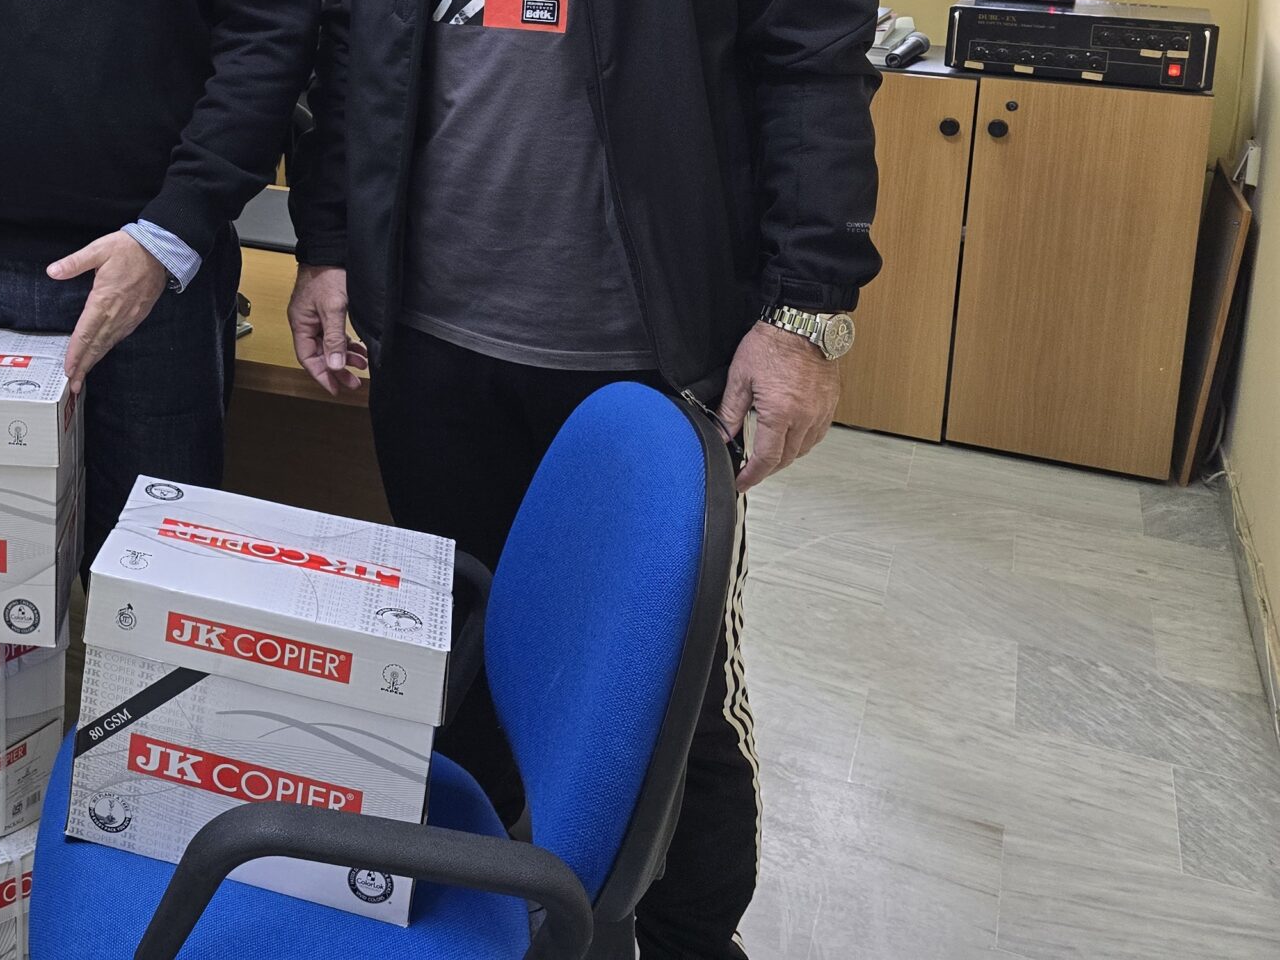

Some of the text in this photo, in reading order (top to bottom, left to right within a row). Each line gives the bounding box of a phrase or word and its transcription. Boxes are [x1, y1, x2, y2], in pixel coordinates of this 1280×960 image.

[172, 619, 226, 651] JK
[88, 708, 133, 741] 80 GSM
[136, 743, 203, 784] JK
